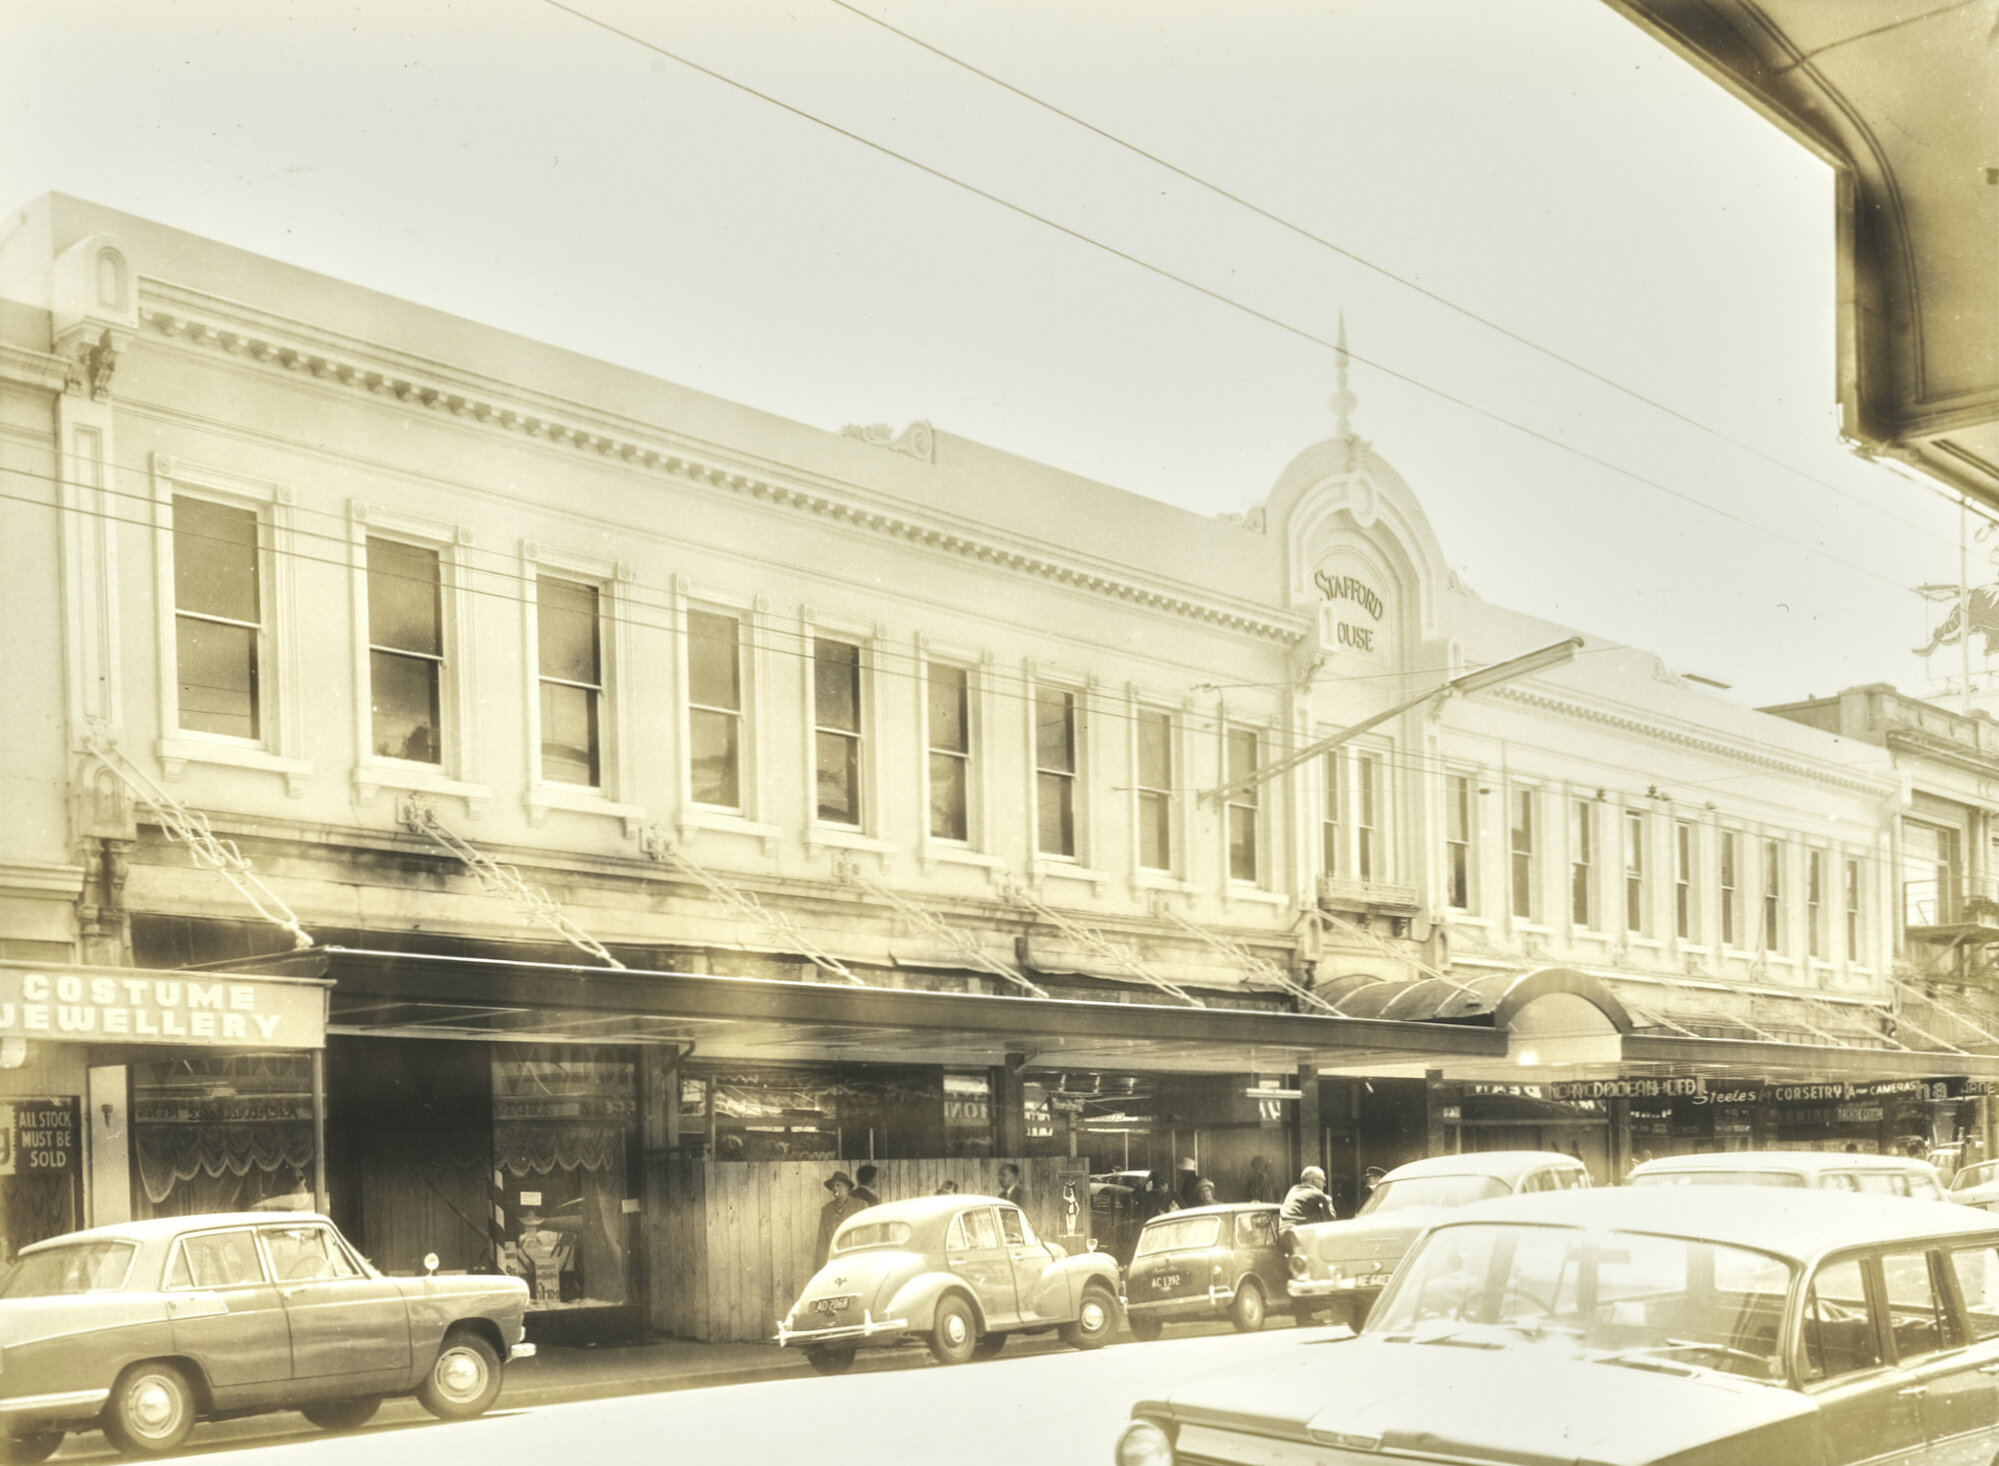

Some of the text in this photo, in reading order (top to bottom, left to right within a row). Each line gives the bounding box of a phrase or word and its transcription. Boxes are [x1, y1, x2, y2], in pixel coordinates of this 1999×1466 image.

[1313, 568, 1383, 621] STAFFORD
[1337, 621, 1374, 652] OUSE
[23, 974, 256, 1010] COSTUME
[1775, 1084, 1843, 1101] CORSETRY
[1869, 1080, 1916, 1096] CAMERAS
[19, 1111, 72, 1128] ALL STOCK
[22, 1131, 53, 1148] MUST
[56, 1131, 72, 1148] BE
[30, 1150, 67, 1168] SOLD
